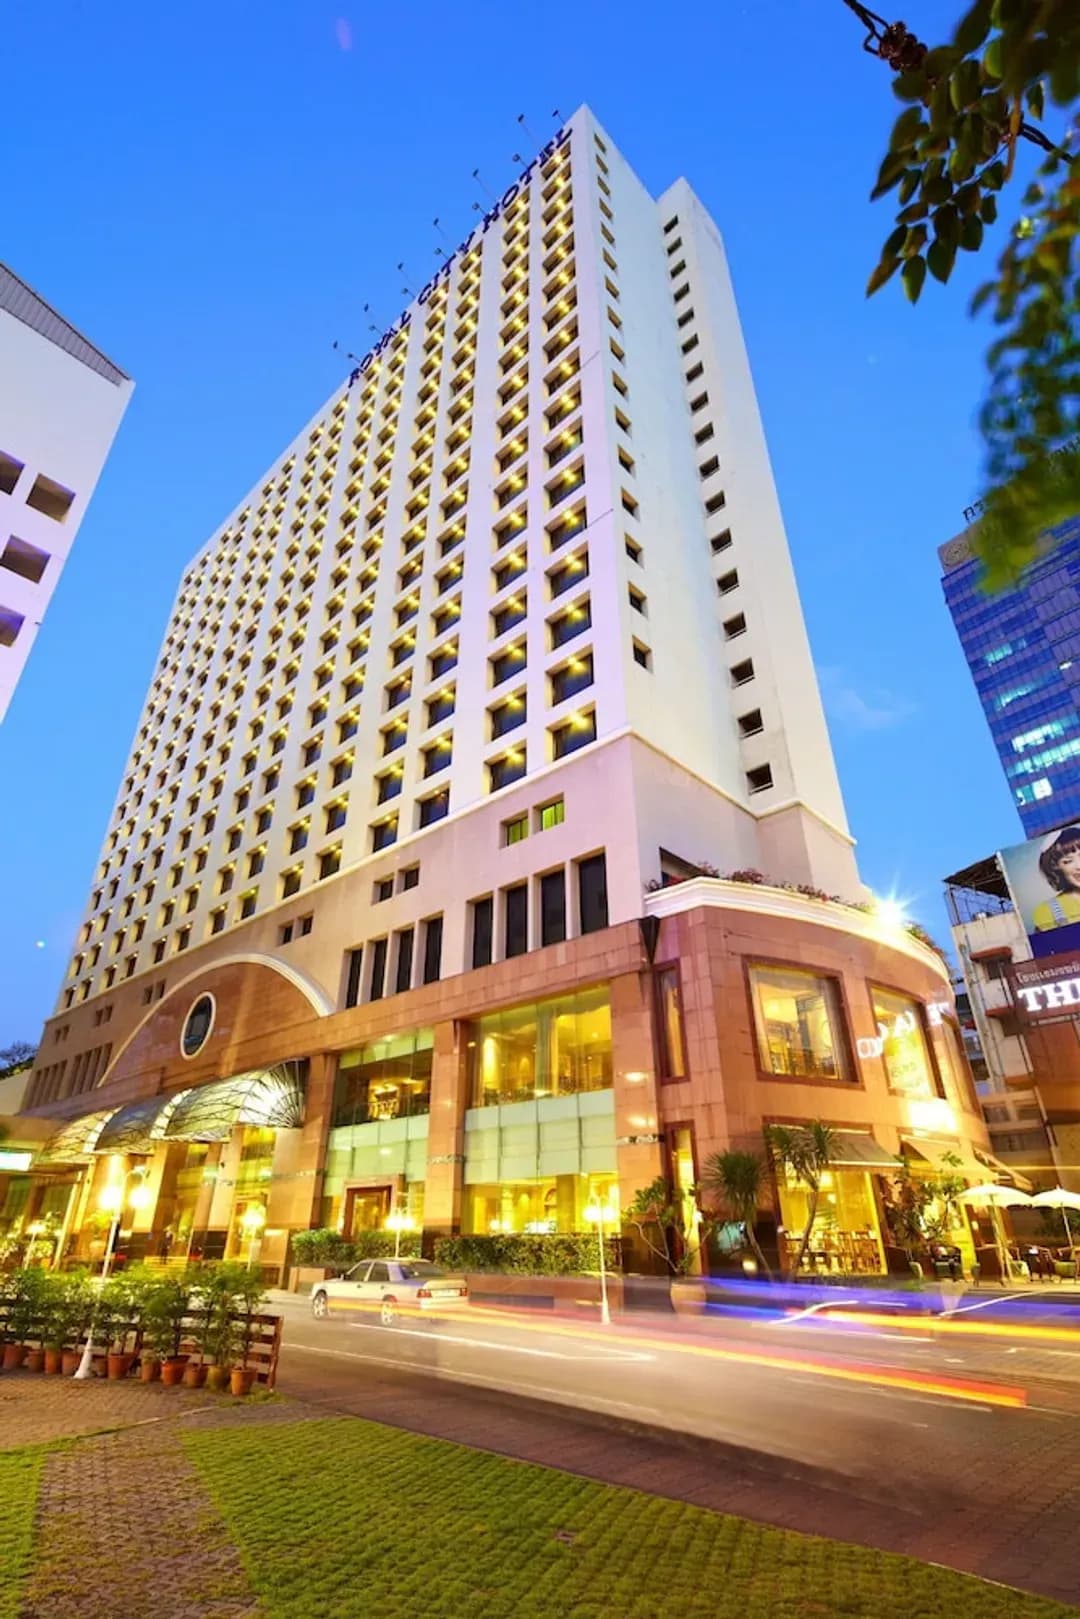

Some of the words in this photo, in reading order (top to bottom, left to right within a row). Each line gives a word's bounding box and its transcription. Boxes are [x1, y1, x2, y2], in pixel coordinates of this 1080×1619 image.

[348, 310, 412, 388] ROYAL
[417, 231, 476, 306] CITY
[482, 128, 573, 234] HOTEL
